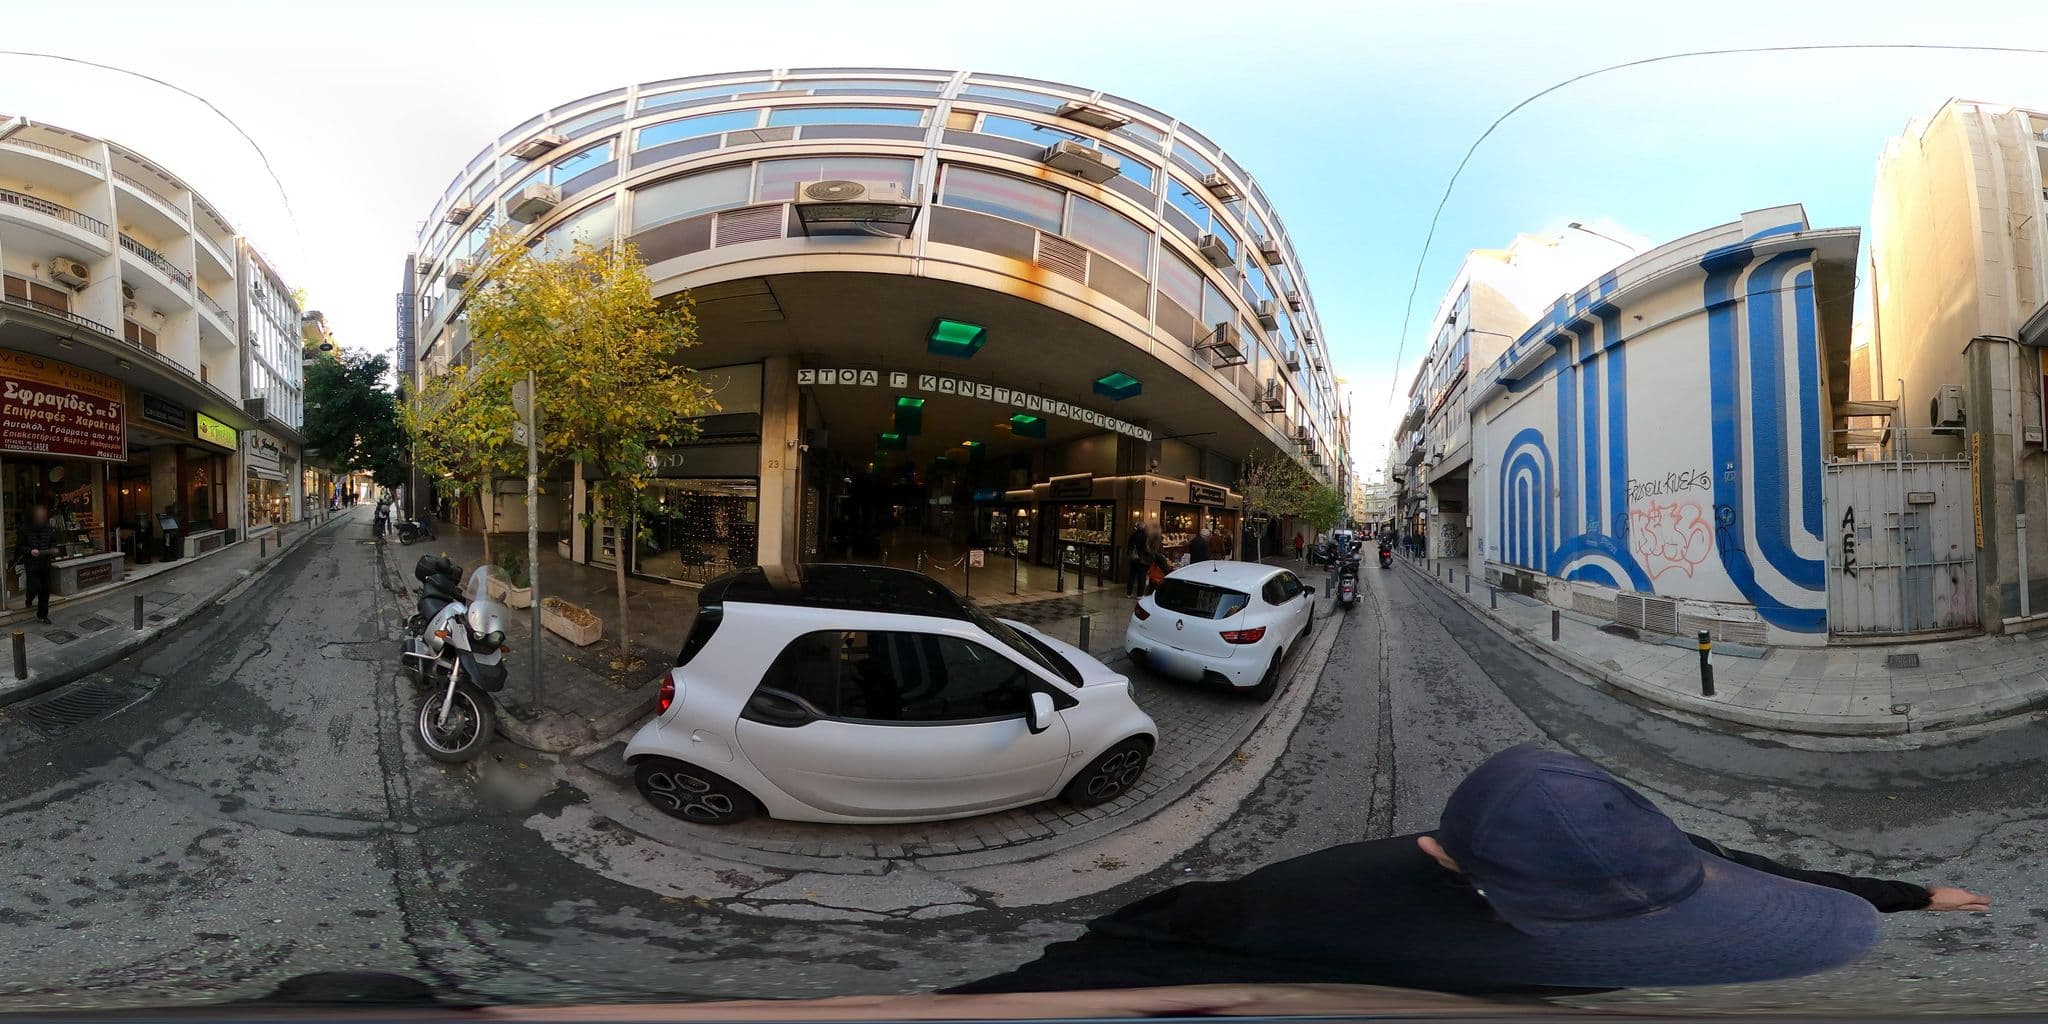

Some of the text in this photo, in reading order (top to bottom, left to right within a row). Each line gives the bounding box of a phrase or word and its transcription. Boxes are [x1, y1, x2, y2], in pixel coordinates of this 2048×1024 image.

[3, 381, 94, 417] Σφραγίδες
[799, 370, 876, 384] ΣΤΟΑ
[922, 376, 1152, 441] ΚΩΝΣΤΑΝΤΑΚΟΠΟΥΛΟΥ
[3, 404, 66, 422] Επιγραφές
[75, 415, 120, 434] Χαρακτική
[768, 460, 779, 469] 23
